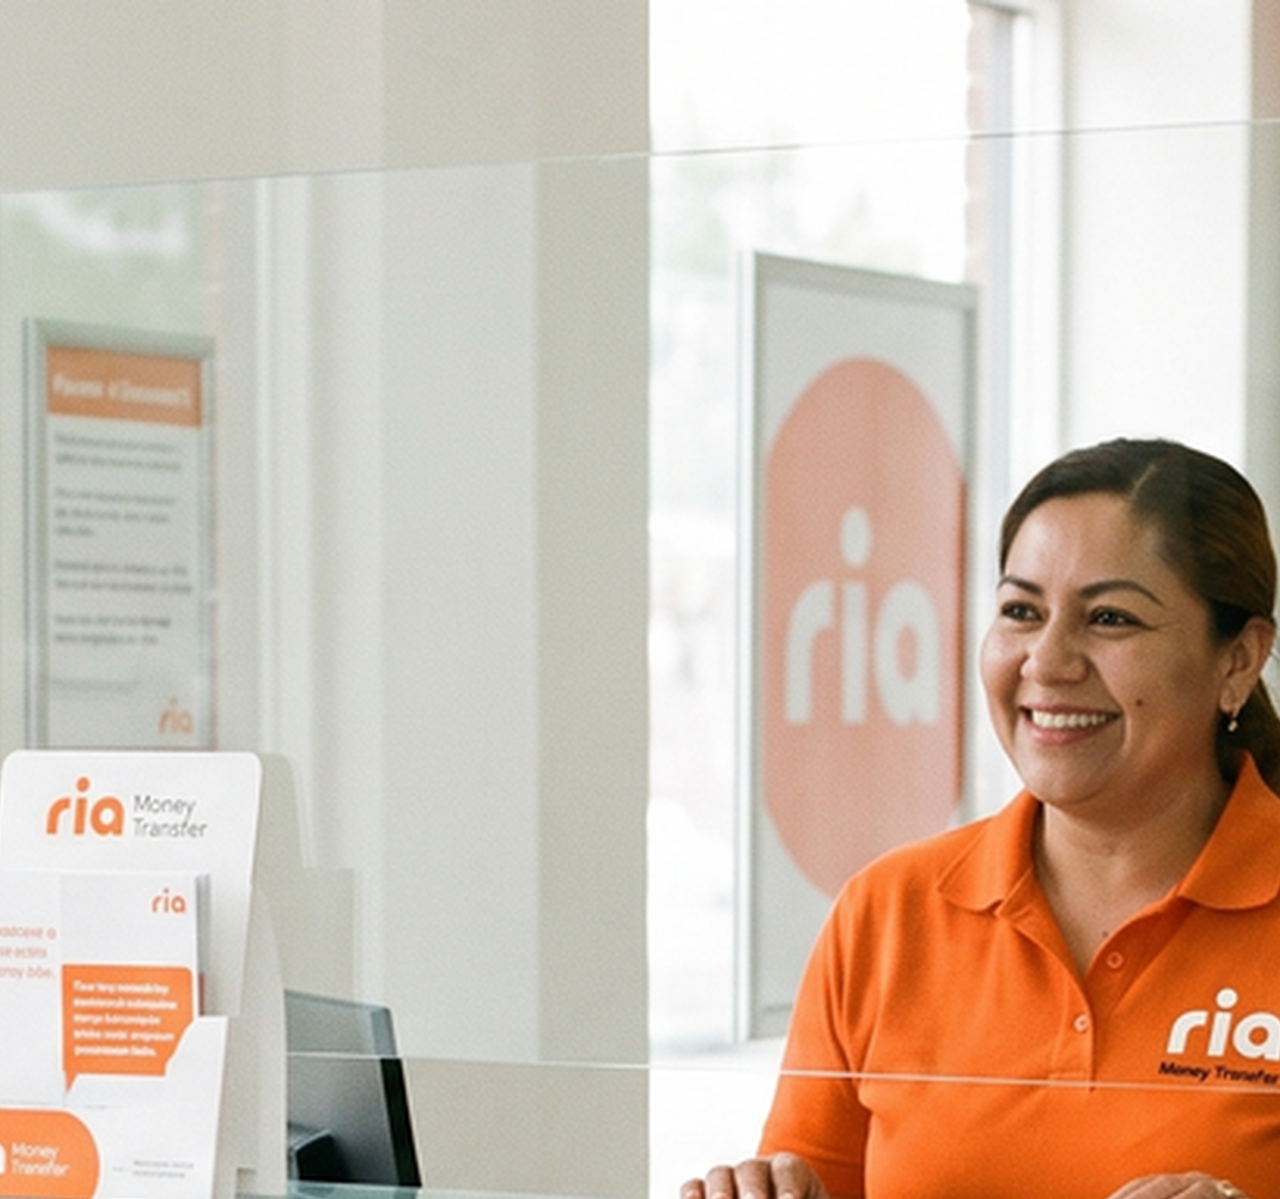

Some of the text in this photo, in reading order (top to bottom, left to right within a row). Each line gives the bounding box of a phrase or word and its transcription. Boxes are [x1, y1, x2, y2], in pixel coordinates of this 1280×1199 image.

[785, 506, 940, 726] ria
[158, 697, 193, 735] ria
[46, 777, 125, 836] ria
[132, 795, 196, 818] Money
[132, 818, 208, 838] Transfer
[151, 888, 187, 914] ria
[1158, 1061, 1280, 1085] Money Transfer
[11, 1142, 60, 1165] Money
